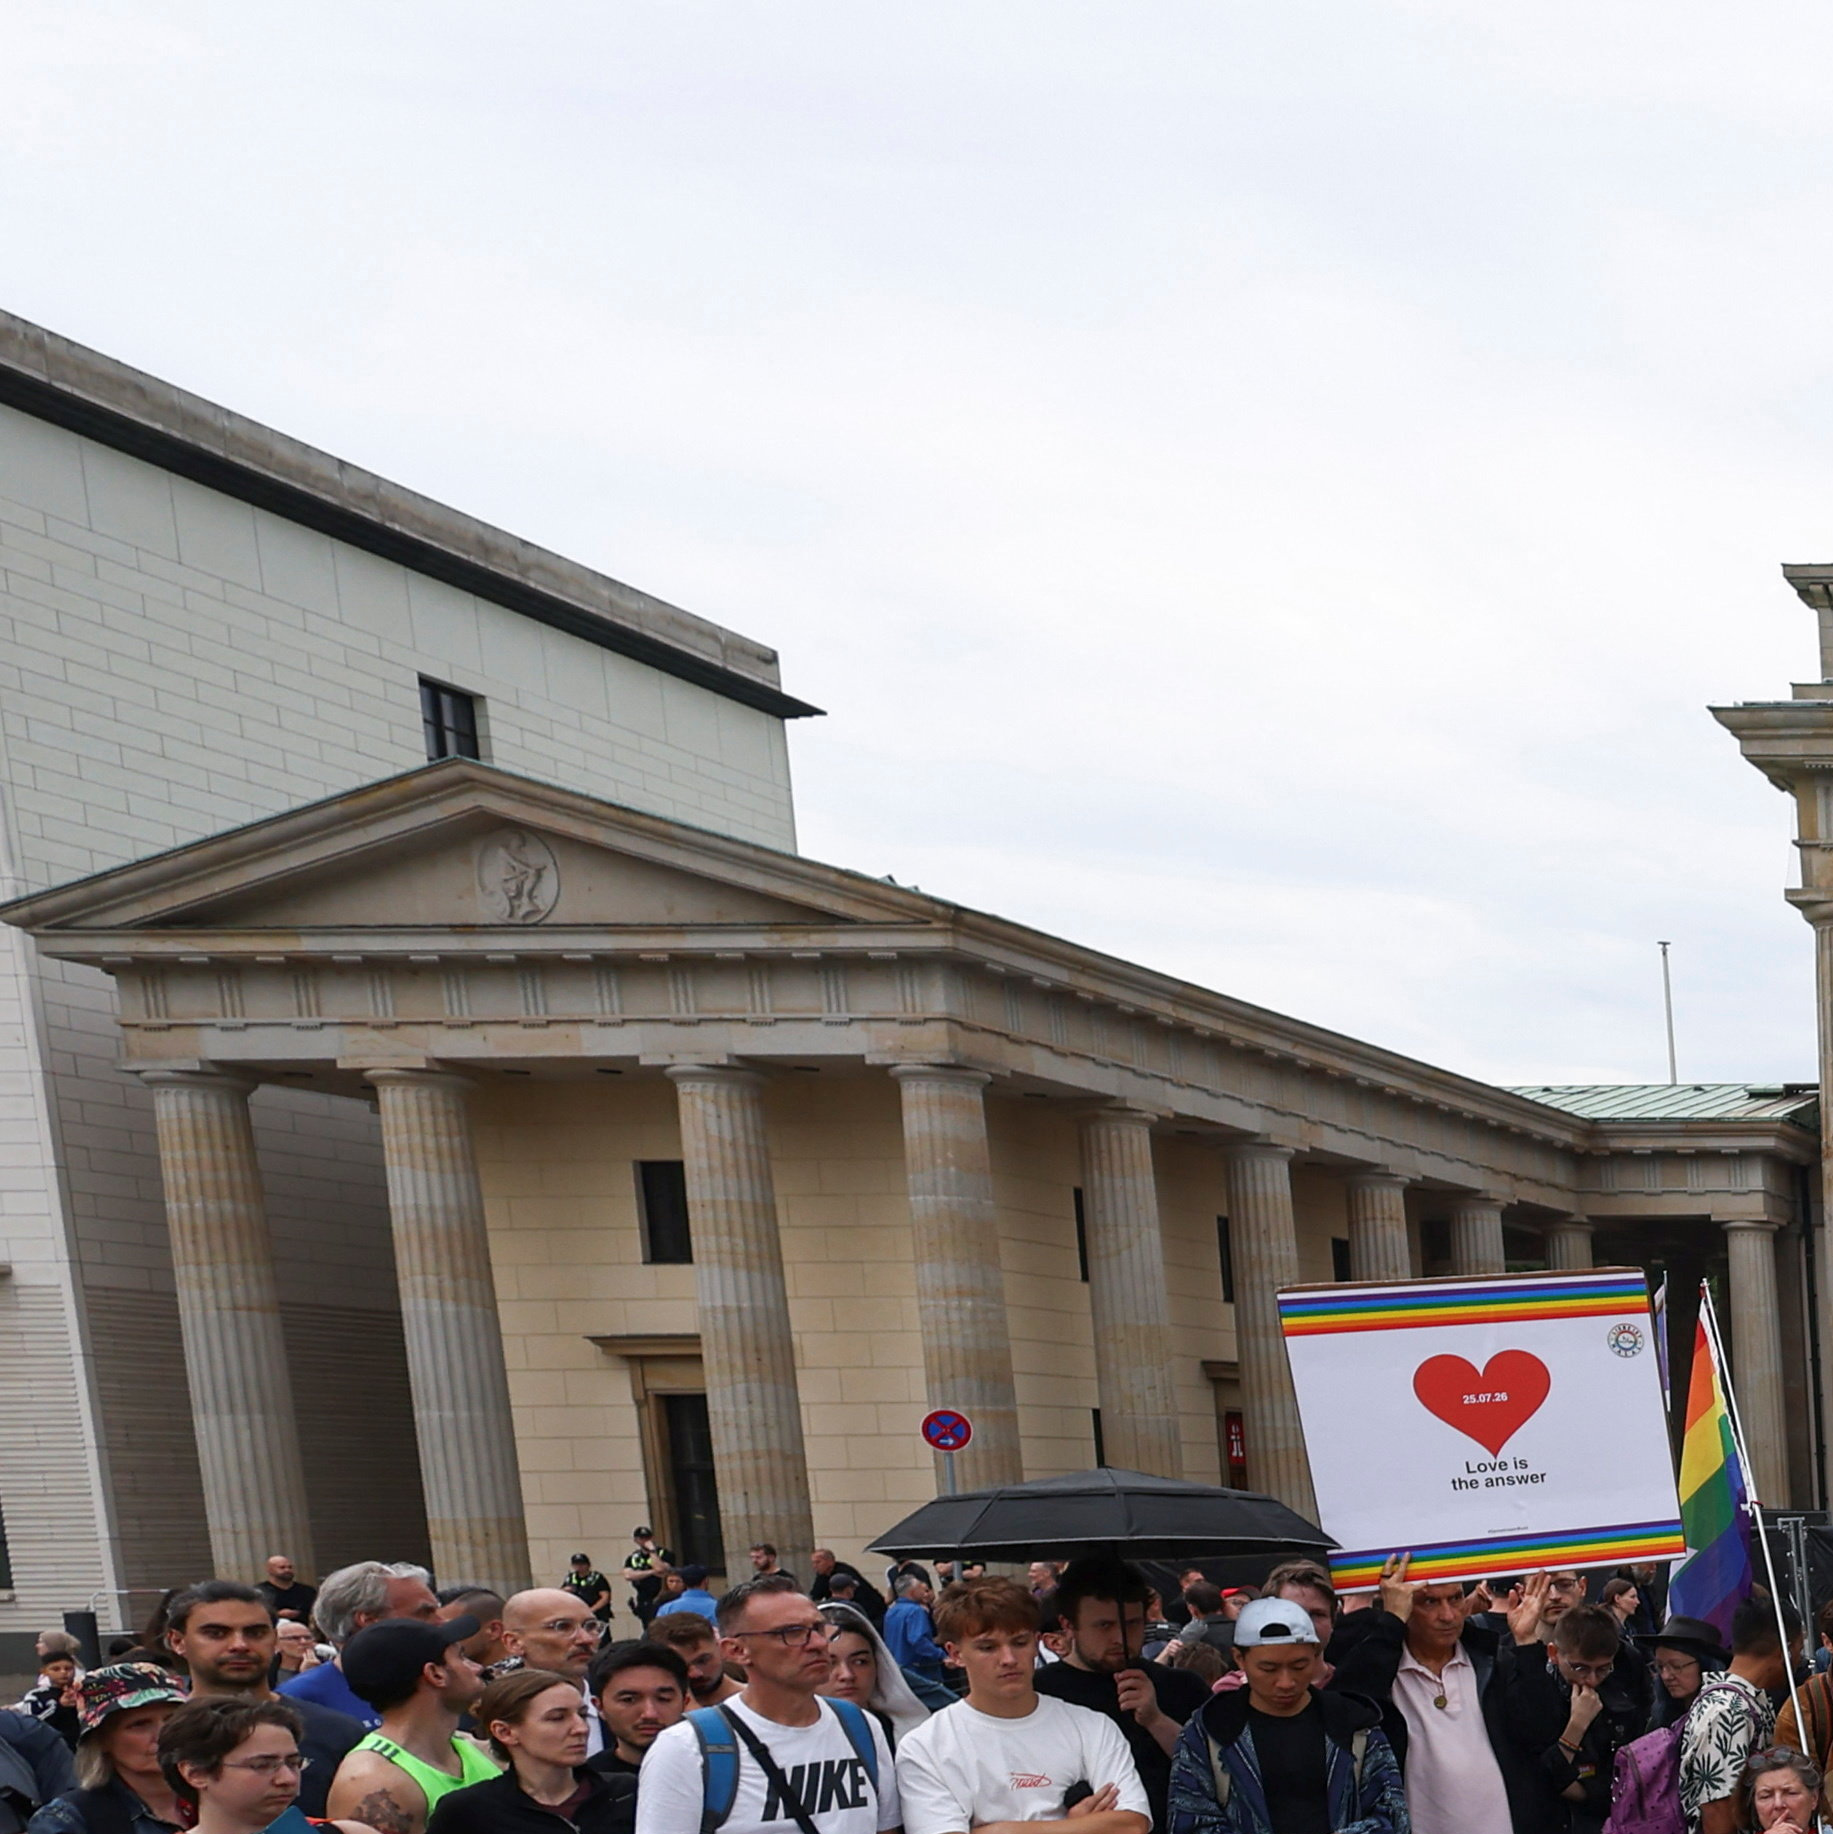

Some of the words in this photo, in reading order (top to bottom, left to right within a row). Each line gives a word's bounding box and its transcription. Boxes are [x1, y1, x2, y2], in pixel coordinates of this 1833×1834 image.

[1461, 1392, 1508, 1405] 25.07.26
[1465, 1458, 1508, 1474] Love
[1513, 1456, 1529, 1472] is
[1451, 1476, 1476, 1490] the
[1479, 1471, 1547, 1488] answer
[760, 1757, 868, 1822] NIKE
